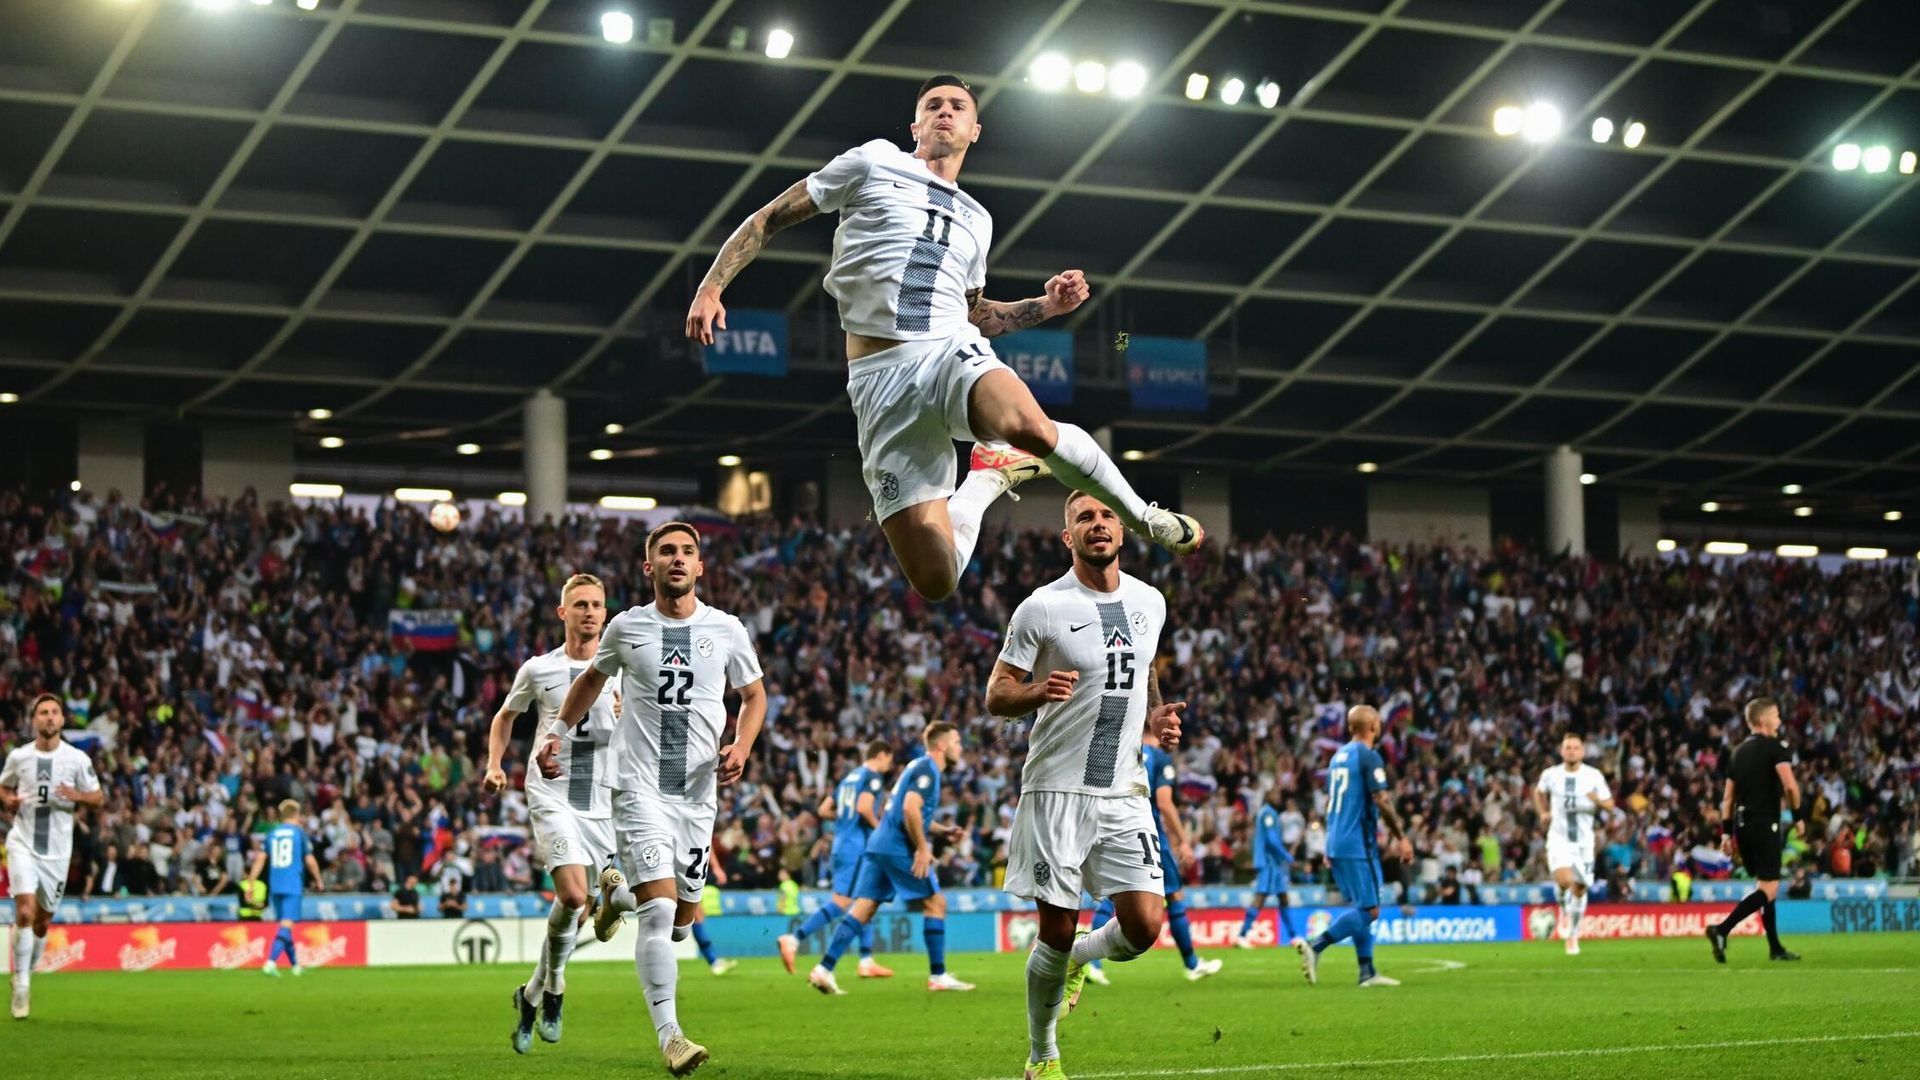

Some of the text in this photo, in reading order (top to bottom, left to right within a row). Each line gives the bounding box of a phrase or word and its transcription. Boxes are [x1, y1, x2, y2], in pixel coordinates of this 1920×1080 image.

[916, 209, 953, 247] 11
[714, 329, 777, 356] FIFA
[955, 343, 990, 362] 11
[1105, 652, 1135, 690] 15
[658, 671, 694, 705] 22
[37, 786, 49, 804] 9
[1327, 768, 1349, 814] 17
[270, 838, 294, 869] 18
